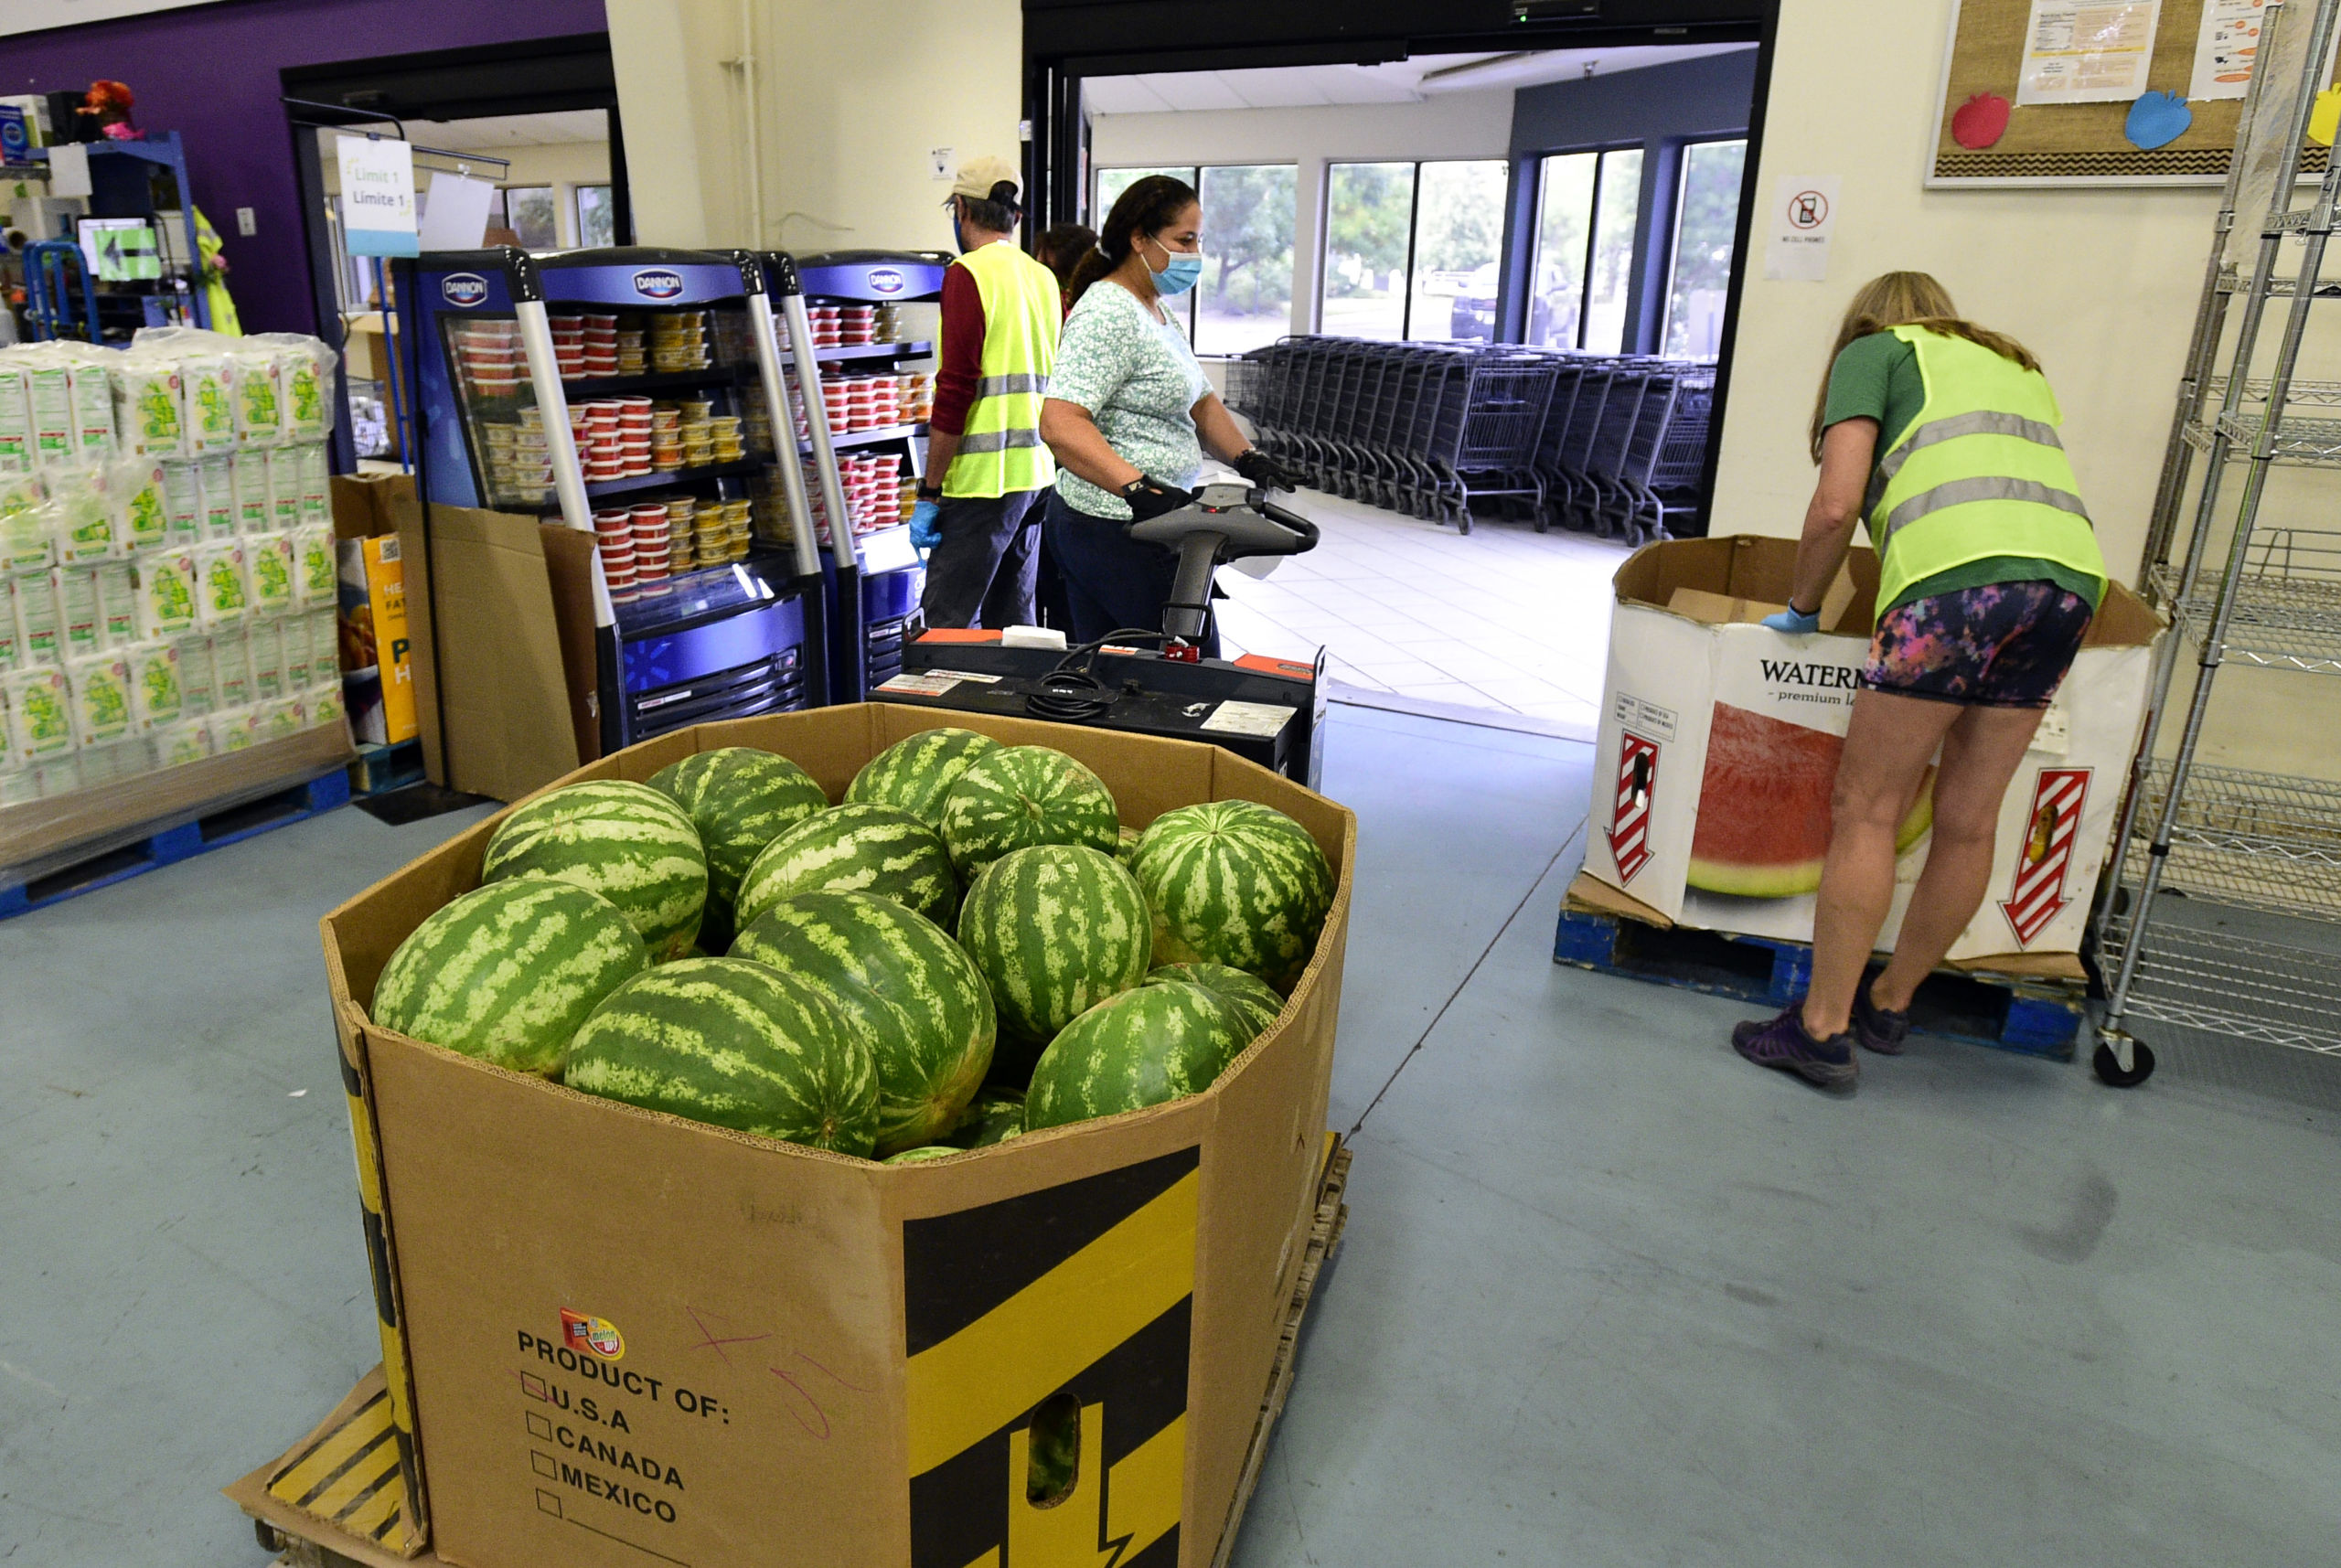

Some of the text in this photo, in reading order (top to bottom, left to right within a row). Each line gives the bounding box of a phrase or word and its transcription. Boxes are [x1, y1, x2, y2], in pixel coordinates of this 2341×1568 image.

[355, 167, 400, 183] Limit 1
[398, 194, 404, 207] 1
[636, 276, 680, 290] DANNON
[870, 274, 902, 286] DANNON
[445, 282, 484, 294] DANNON
[1778, 691, 1841, 705] premium
[592, 1328, 616, 1342] melon
[518, 1330, 663, 1403] PRODUCT
[675, 1388, 731, 1425] OF:
[551, 1385, 630, 1434] U.S.A
[557, 1426, 685, 1491] CANADA
[561, 1463, 677, 1524] MEXICO
